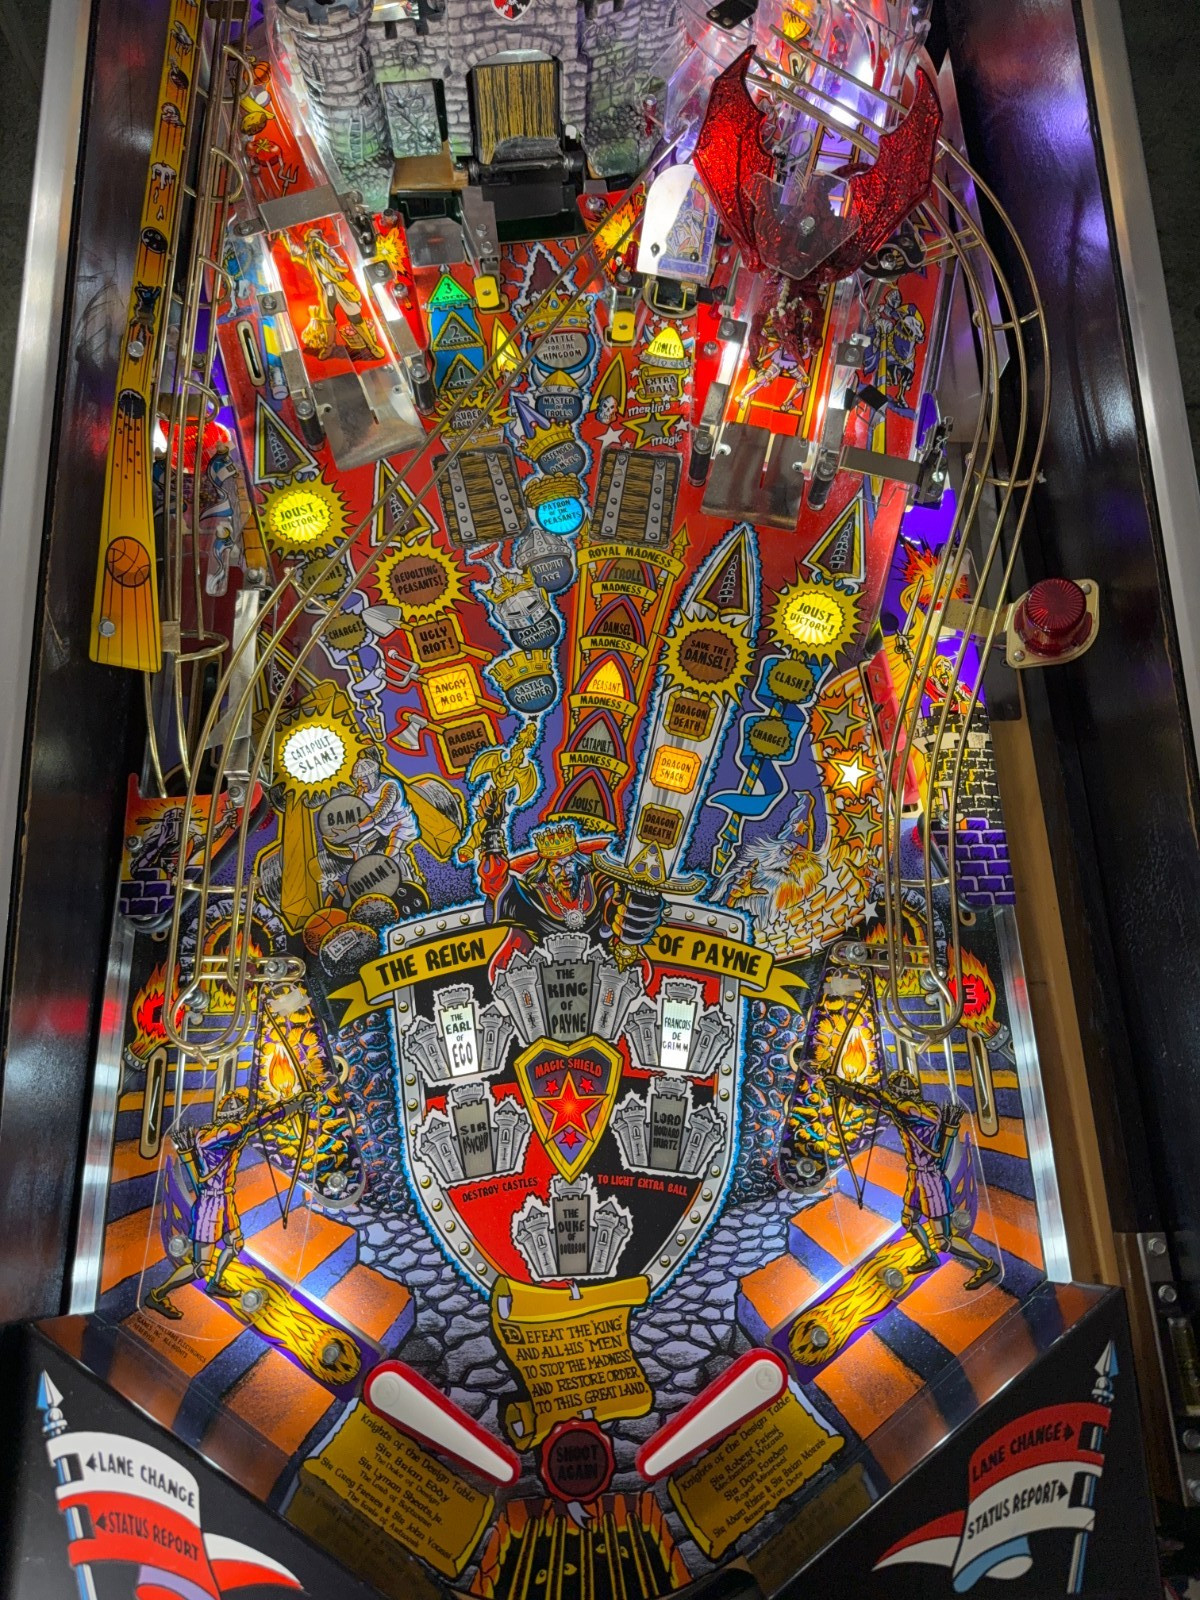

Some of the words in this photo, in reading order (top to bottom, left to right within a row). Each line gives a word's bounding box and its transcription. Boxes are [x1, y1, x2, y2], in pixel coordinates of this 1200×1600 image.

[444, 282, 452, 294] 3
[449, 325, 460, 338] 2
[543, 349, 582, 360] KINGDOM
[653, 340, 681, 355] TROLLS!
[645, 376, 675, 387] EXTRA
[649, 384, 675, 395] BALL
[543, 397, 575, 405] MASTER
[545, 409, 574, 417] TROLLS
[541, 442, 575, 463] DEFENDER
[550, 454, 581, 474] DAMSELS
[280, 502, 315, 522] JOUST
[542, 499, 571, 511] PATRON
[280, 509, 326, 530] VICTORY!
[543, 511, 582, 526] PEASANTS
[588, 547, 621, 559] ROYAL
[625, 546, 673, 568] MADNESS
[394, 564, 438, 583] REVOLTING
[541, 572, 561, 583] ACE
[613, 568, 641, 581] TROLL
[397, 574, 444, 594] PEASANTS!
[797, 602, 834, 623] JOUST
[328, 620, 363, 640] CHARGE!
[517, 617, 553, 639] JOUST
[603, 620, 631, 636] DAMSEL
[790, 612, 834, 636] VICTORY!
[419, 625, 448, 643] UGLY
[522, 626, 557, 647] CHAMPION
[421, 637, 454, 655] RIOT!
[690, 639, 711, 651] SAVE
[713, 644, 729, 656] THE
[683, 651, 730, 672] DAMSEL!
[435, 678, 467, 694] ANGRY
[513, 678, 544, 696] CASTLE
[592, 678, 621, 693] PEASANT
[774, 670, 810, 692] CLASH!
[440, 691, 470, 706] MOB!
[514, 684, 553, 705] CRUSHER
[675, 704, 708, 720] DRAGON
[673, 716, 701, 731] DEATH
[448, 728, 484, 746] RABBLE
[752, 727, 787, 748] CHARGE!
[290, 736, 331, 761] CATAPULT
[299, 747, 339, 774] SLAM!
[661, 756, 691, 772] DRAGON
[659, 768, 685, 784] SNACK
[570, 796, 600, 814] JOUST
[326, 806, 362, 827] BAM!
[646, 813, 676, 828] DRAGON
[643, 824, 672, 840] BREATH
[350, 859, 397, 899] WHAM!
[376, 957, 418, 986] THE
[426, 937, 486, 973] REIGN
[657, 932, 684, 955] OF
[691, 938, 762, 978] PAYNE
[555, 968, 575, 980] THE
[547, 981, 588, 999] KING
[560, 1001, 574, 1011] OF
[450, 1012, 464, 1021] THE
[551, 1012, 587, 1035] PAYNE
[445, 1020, 472, 1035] EARL
[671, 1031, 682, 1041] DE
[456, 1033, 465, 1042] OF
[662, 1040, 689, 1052] GRIMM
[451, 1041, 473, 1069] EGO
[533, 1059, 567, 1079] MAGIC
[567, 1058, 603, 1078] SHIELD
[653, 1112, 682, 1126] LORD
[459, 1121, 487, 1137] SIR
[653, 1126, 680, 1140] HOWARD
[462, 1132, 489, 1156] PSYCHO
[653, 1137, 679, 1151] HURTZ
[462, 1185, 500, 1203] DESTROY
[501, 1177, 539, 1193] CASTLES
[597, 1174, 609, 1185] TO
[611, 1176, 634, 1189] LIGHT
[637, 1177, 665, 1192] EXTRA
[667, 1183, 689, 1197] BALL
[562, 1208, 580, 1219] THE
[558, 1220, 585, 1233] DUKE
[567, 1232, 576, 1241] OF
[565, 1326, 591, 1339] THE
[516, 1348, 540, 1361] AND
[541, 1346, 564, 1359] ALL
[564, 1342, 584, 1356] HIS
[523, 1365, 538, 1379] TO
[540, 1363, 565, 1378] STOP
[566, 1359, 587, 1372] THE
[588, 1349, 632, 1370] MADNESS
[532, 1383, 554, 1398] AND
[556, 1371, 606, 1392] RESTORE
[606, 1366, 640, 1385] ORDER
[535, 1401, 552, 1414] TO
[554, 1393, 583, 1410] THIS
[584, 1387, 618, 1403] GREAT
[619, 1381, 649, 1398] LAND.
[681, 1460, 713, 1492] Knights
[714, 1453, 723, 1465] of
[725, 1439, 740, 1455] the
[739, 1415, 768, 1440] Design
[767, 1395, 791, 1416] Table
[972, 1446, 1005, 1483] LANE
[1009, 1422, 1062, 1455] CHANGE
[360, 1413, 393, 1442] Knights
[393, 1441, 404, 1451] of
[405, 1448, 420, 1462] the
[421, 1457, 451, 1483] Design
[452, 1481, 476, 1503] Table
[710, 1473, 723, 1487] Sir
[724, 1447, 755, 1476] Robert
[98, 1451, 135, 1478] LANE
[140, 1465, 196, 1509] CHANGE
[375, 1443, 392, 1458] Sir
[396, 1456, 423, 1482] Brian
[425, 1480, 450, 1502] Eddy
[723, 1487, 738, 1502] Sir
[739, 1471, 758, 1488] Dan
[757, 1444, 789, 1472] Forden
[967, 1497, 1011, 1540] STATUS
[1012, 1479, 1060, 1515] REPORT
[108, 1511, 149, 1540] STATUS
[153, 1525, 199, 1562] REPORT
